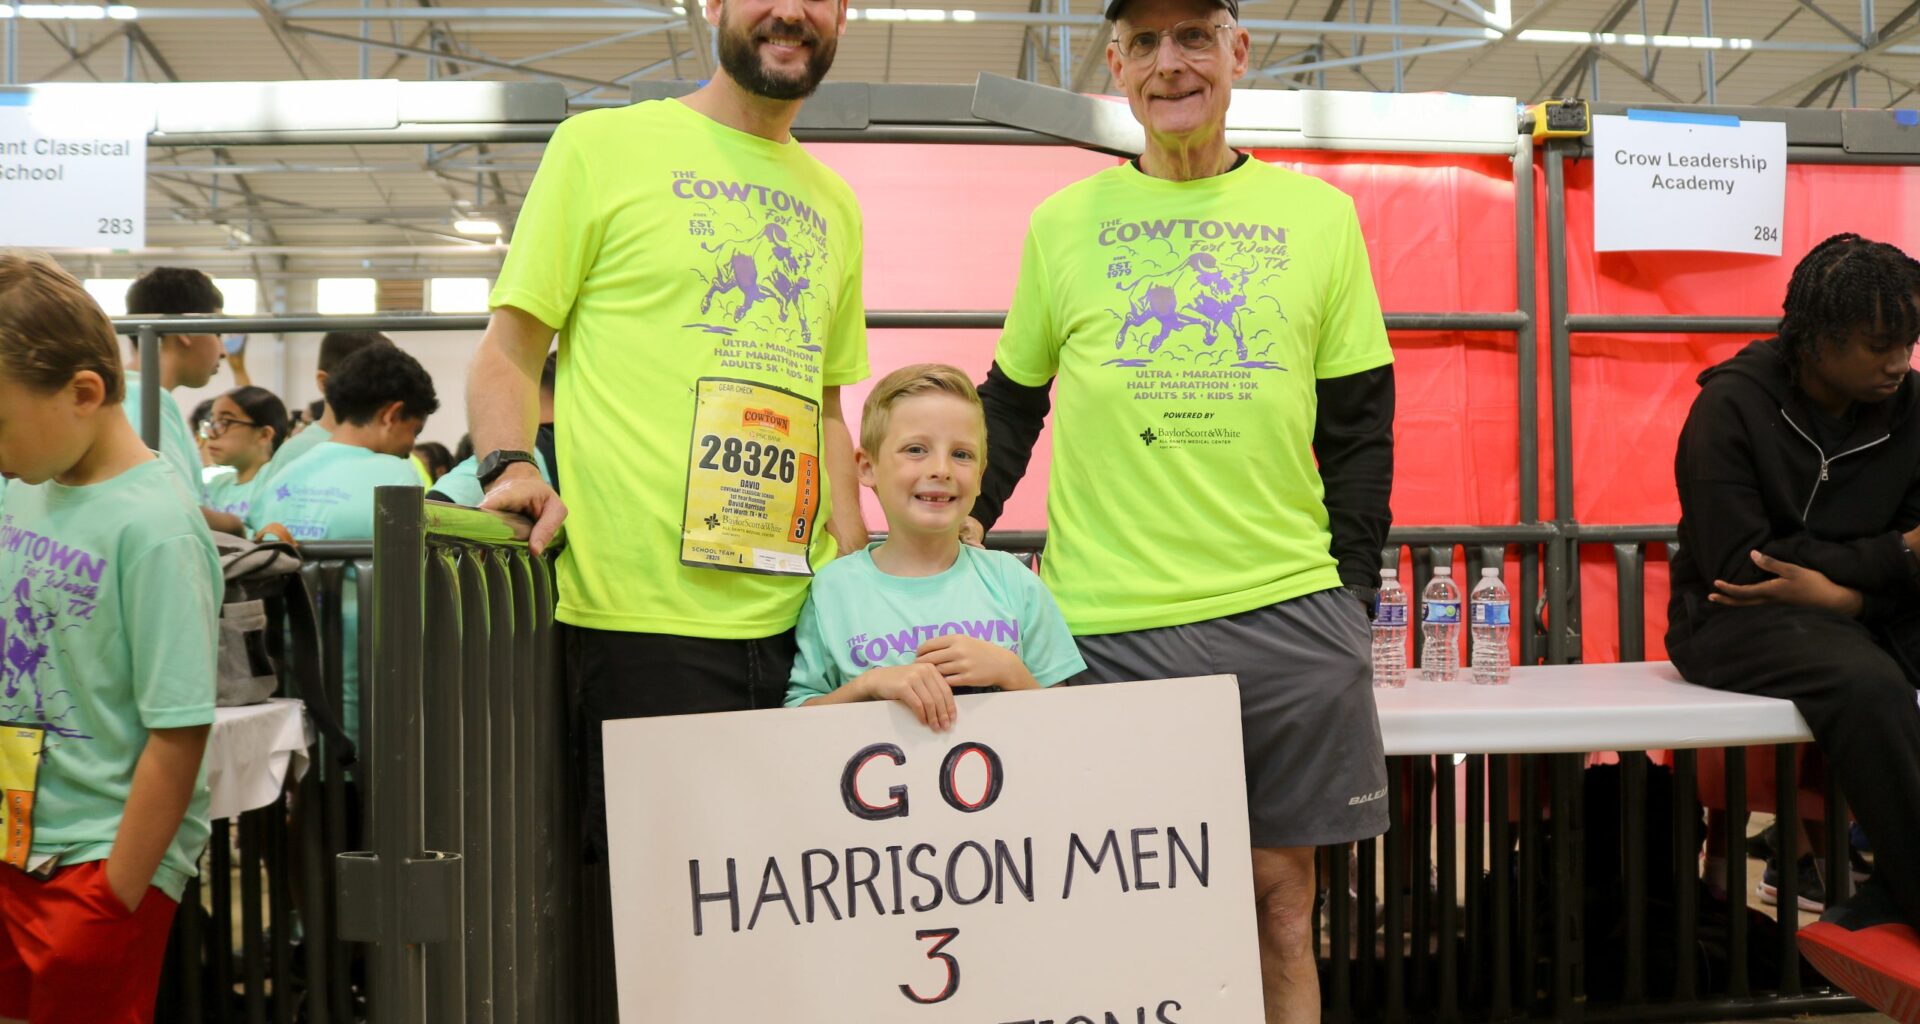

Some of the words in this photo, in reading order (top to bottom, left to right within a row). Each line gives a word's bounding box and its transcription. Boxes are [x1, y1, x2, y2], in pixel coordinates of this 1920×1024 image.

[34, 138, 130, 156] Classical
[1614, 150, 1662, 166] Crow
[1668, 152, 1767, 173] Leadership
[672, 170, 697, 179] THE
[1651, 174, 1735, 195] Academy
[672, 178, 827, 236] COWTOWN
[765, 207, 792, 226] Fort
[1100, 218, 1122, 229] THE
[98, 217, 134, 235] 283
[688, 227, 715, 236] 1979
[1098, 218, 1286, 246] COWTOWN
[1754, 225, 1778, 242] 284
[1189, 240, 1225, 253] Fort
[1264, 256, 1291, 271] TX
[1107, 268, 1132, 279] 1979
[722, 338, 757, 348] ULTRA
[714, 348, 742, 357] HALF
[805, 364, 819, 374] 10K
[720, 360, 762, 370] ADULTS
[766, 364, 778, 373] 5K
[1135, 370, 1172, 379] ULTRA
[1183, 370, 1251, 379] MARATHON
[719, 384, 734, 392] GEAR
[735, 385, 753, 395] CHECK
[1127, 381, 1156, 389] HALF
[1160, 381, 1229, 390] MARATHON
[1239, 381, 1259, 390] 10K
[1134, 391, 1177, 400] ADULTS
[1182, 392, 1197, 400] 5K
[1207, 392, 1234, 400] KIDS
[1238, 392, 1253, 400] 5K
[744, 410, 788, 430] COWTOWN
[698, 434, 796, 484] 28326
[740, 479, 760, 491] DAVID
[801, 459, 812, 515] CORRAL
[722, 506, 733, 514] Fort
[795, 518, 806, 539] 3
[692, 546, 717, 555] SCHOOL
[846, 632, 869, 647] THE
[850, 619, 1019, 668] COWTOWN
[840, 741, 1004, 821] GO
[688, 837, 1034, 936] HARRISON
[1062, 822, 1209, 900] MEN
[898, 927, 960, 1005] 3
